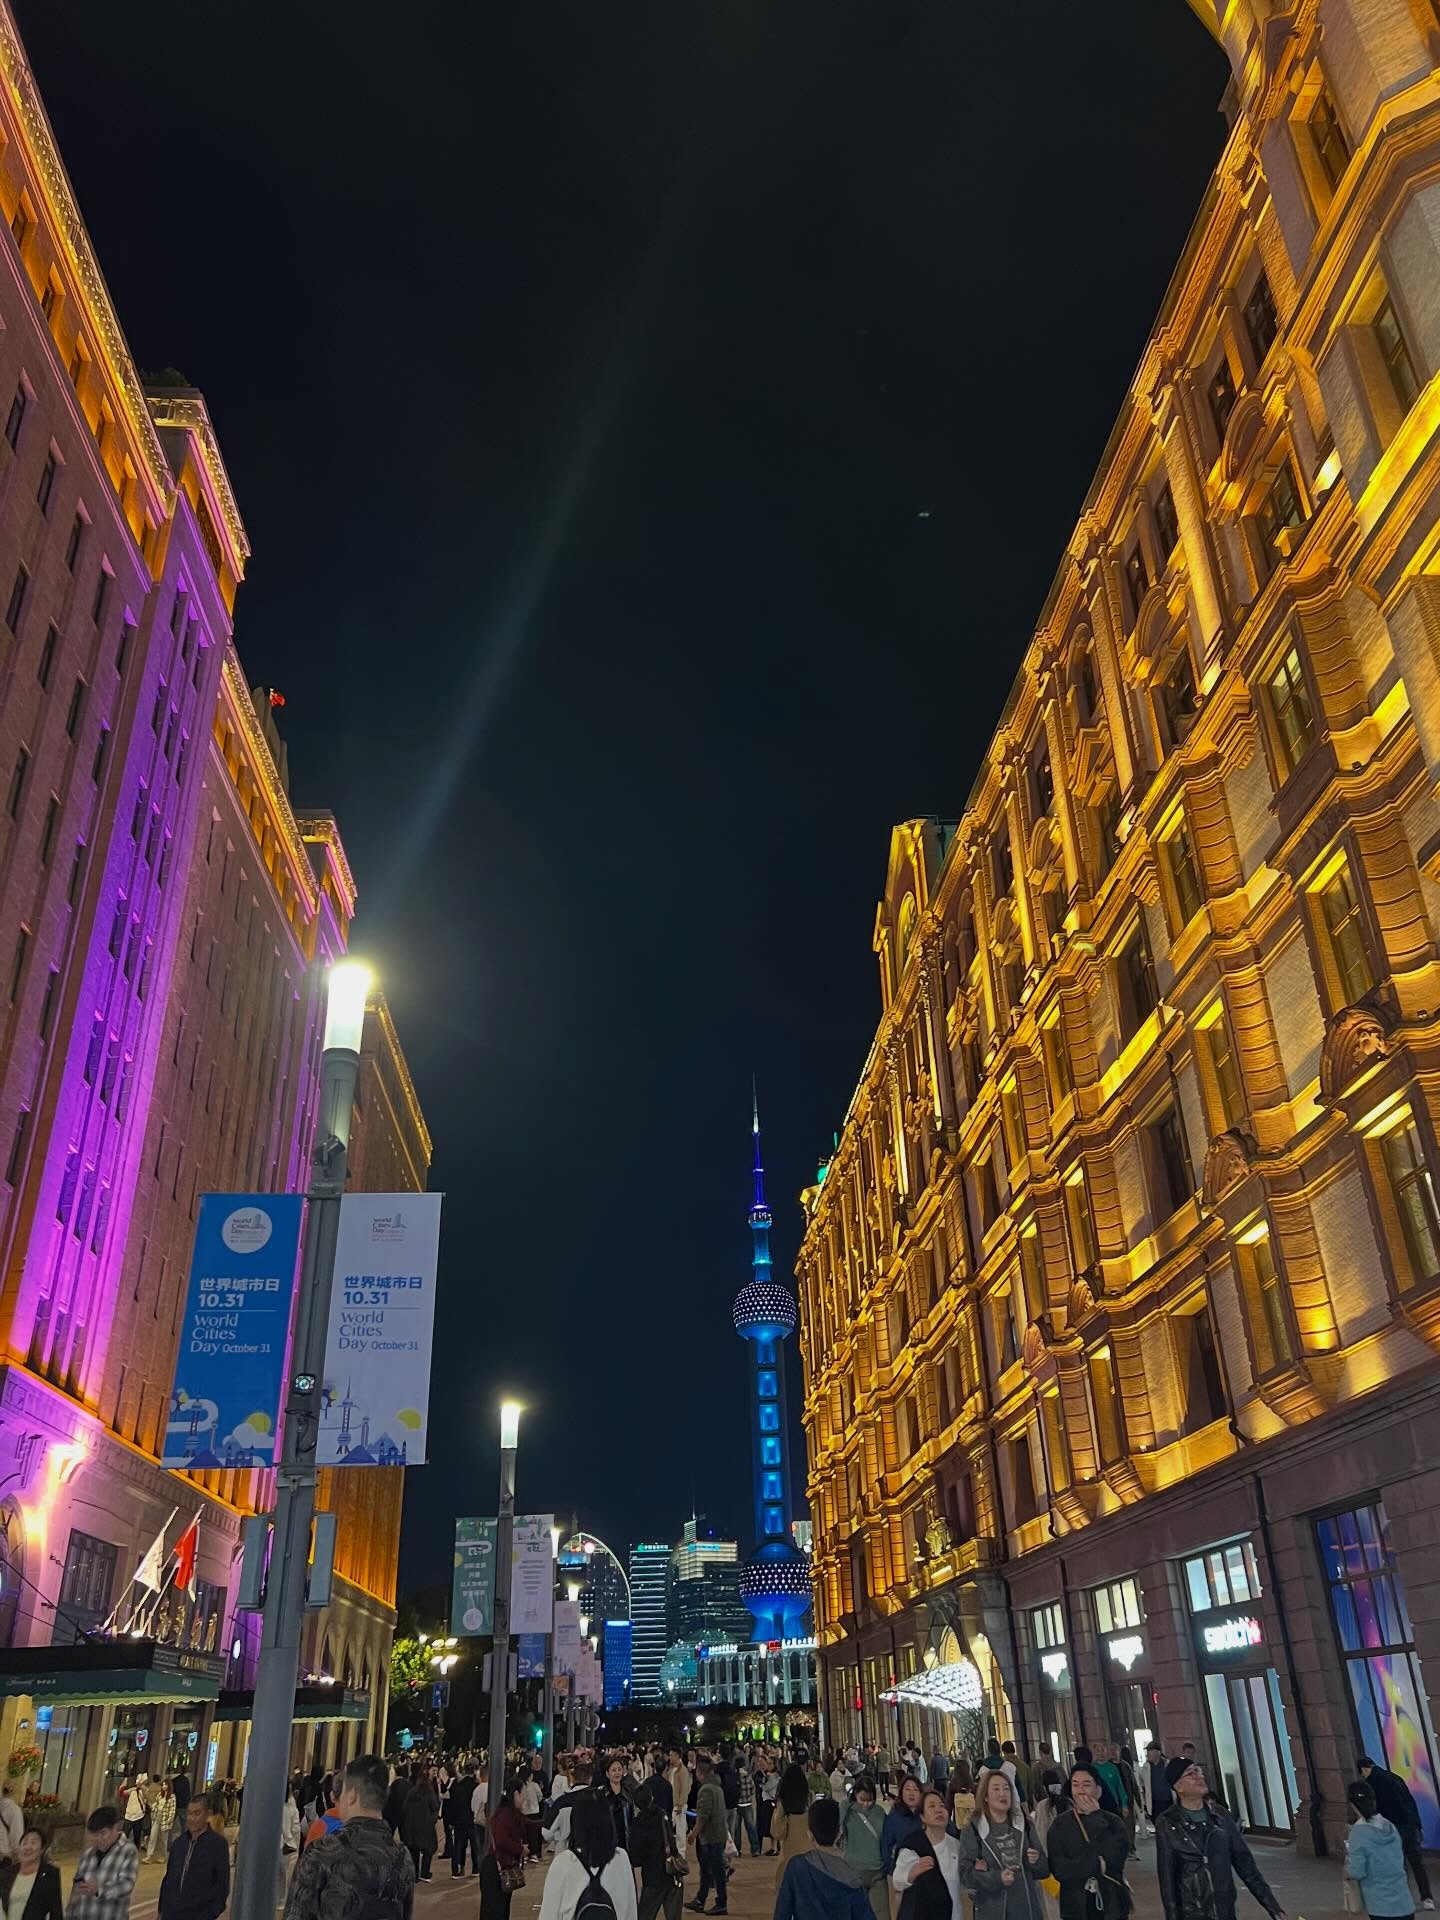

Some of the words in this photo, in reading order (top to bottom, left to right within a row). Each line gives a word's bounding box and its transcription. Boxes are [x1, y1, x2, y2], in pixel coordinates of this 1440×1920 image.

[200, 1277, 281, 1292] 世界城市日
[344, 1276, 423, 1289] 世界城市日
[198, 1293, 244, 1308] 10.31
[343, 1291, 389, 1305] 10.31
[193, 1313, 238, 1327] World
[341, 1311, 384, 1324] World
[192, 1326, 236, 1340] Cities
[339, 1323, 383, 1337] Cities
[190, 1340, 221, 1356] Day
[222, 1343, 260, 1353] October
[260, 1343, 271, 1353] 31
[338, 1337, 370, 1351] Day
[371, 1340, 406, 1351] October
[407, 1341, 419, 1350] 31
